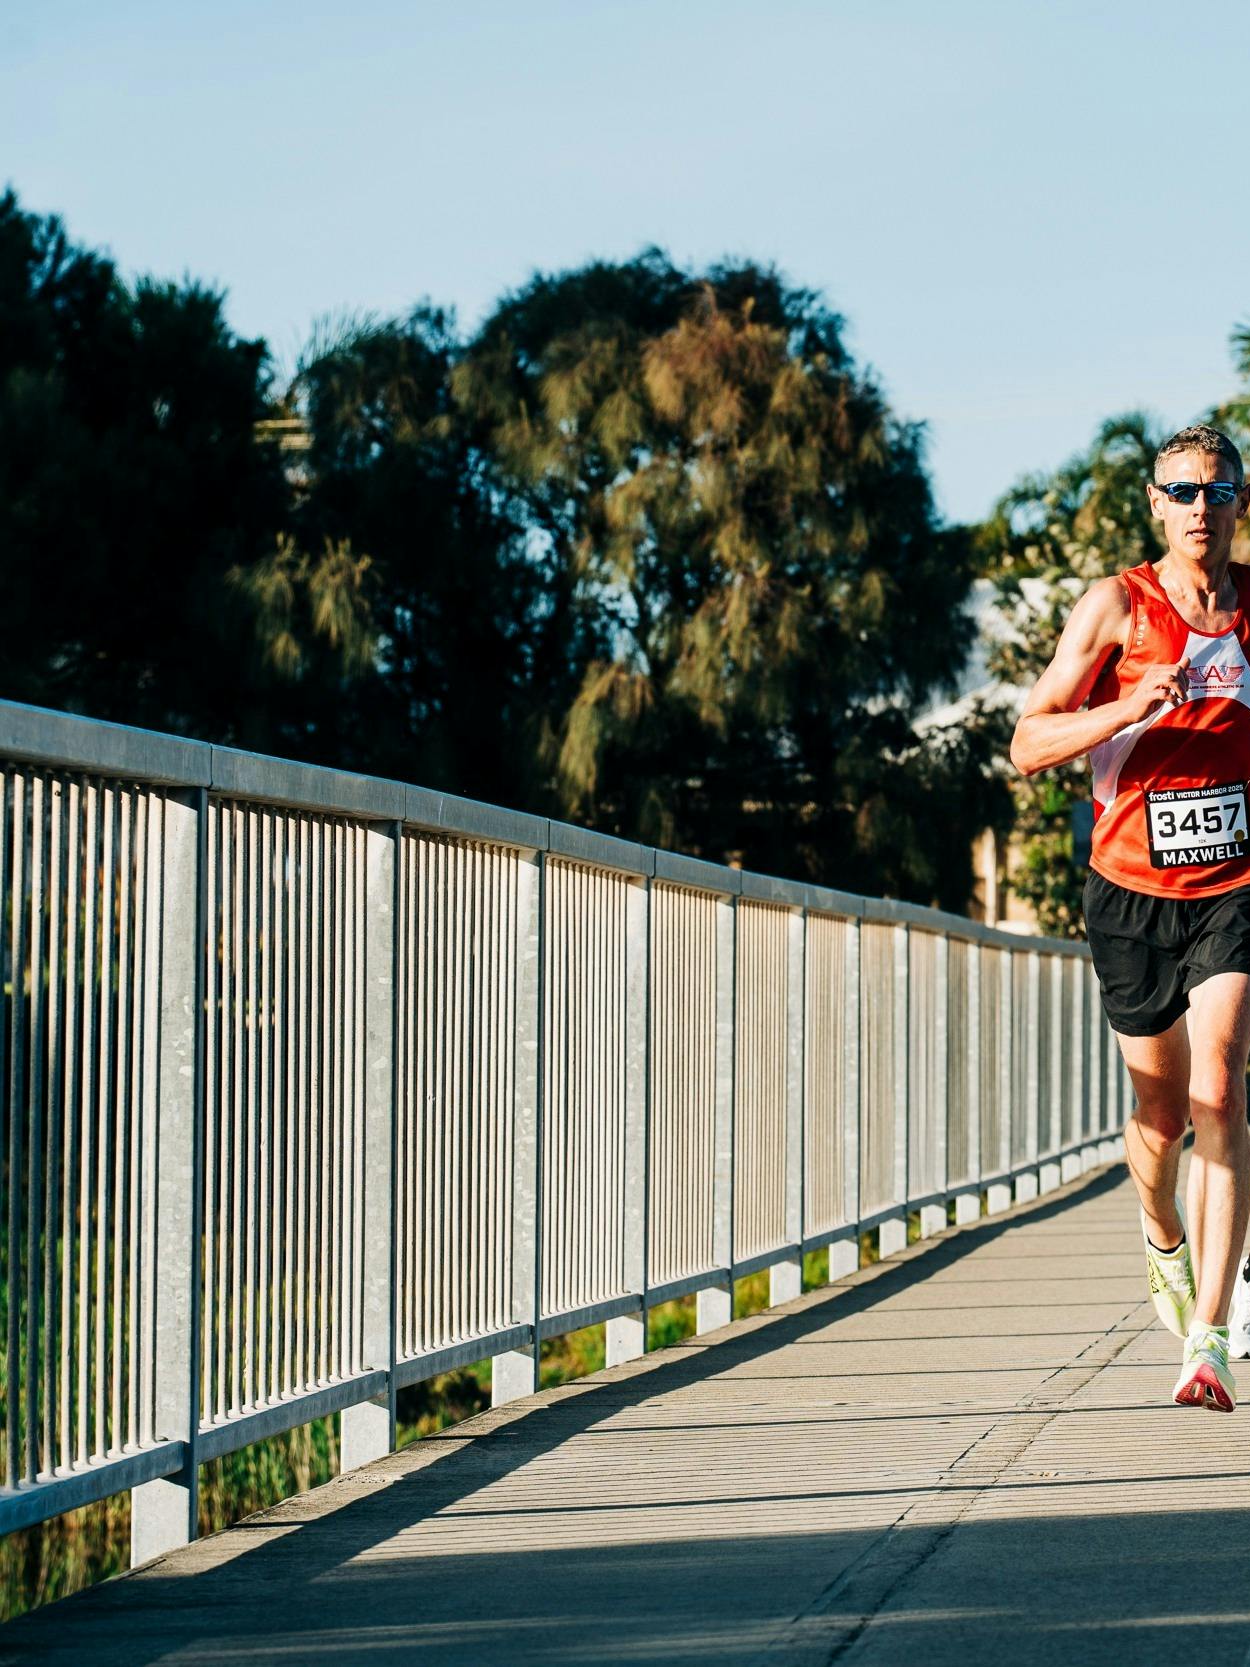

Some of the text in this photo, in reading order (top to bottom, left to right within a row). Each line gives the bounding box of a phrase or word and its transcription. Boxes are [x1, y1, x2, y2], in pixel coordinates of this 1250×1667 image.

[1148, 784, 1244, 802] frosti VICTOR HARBOR 2025
[1157, 801, 1241, 838] 3457
[1162, 843, 1244, 866] MAXWELL
